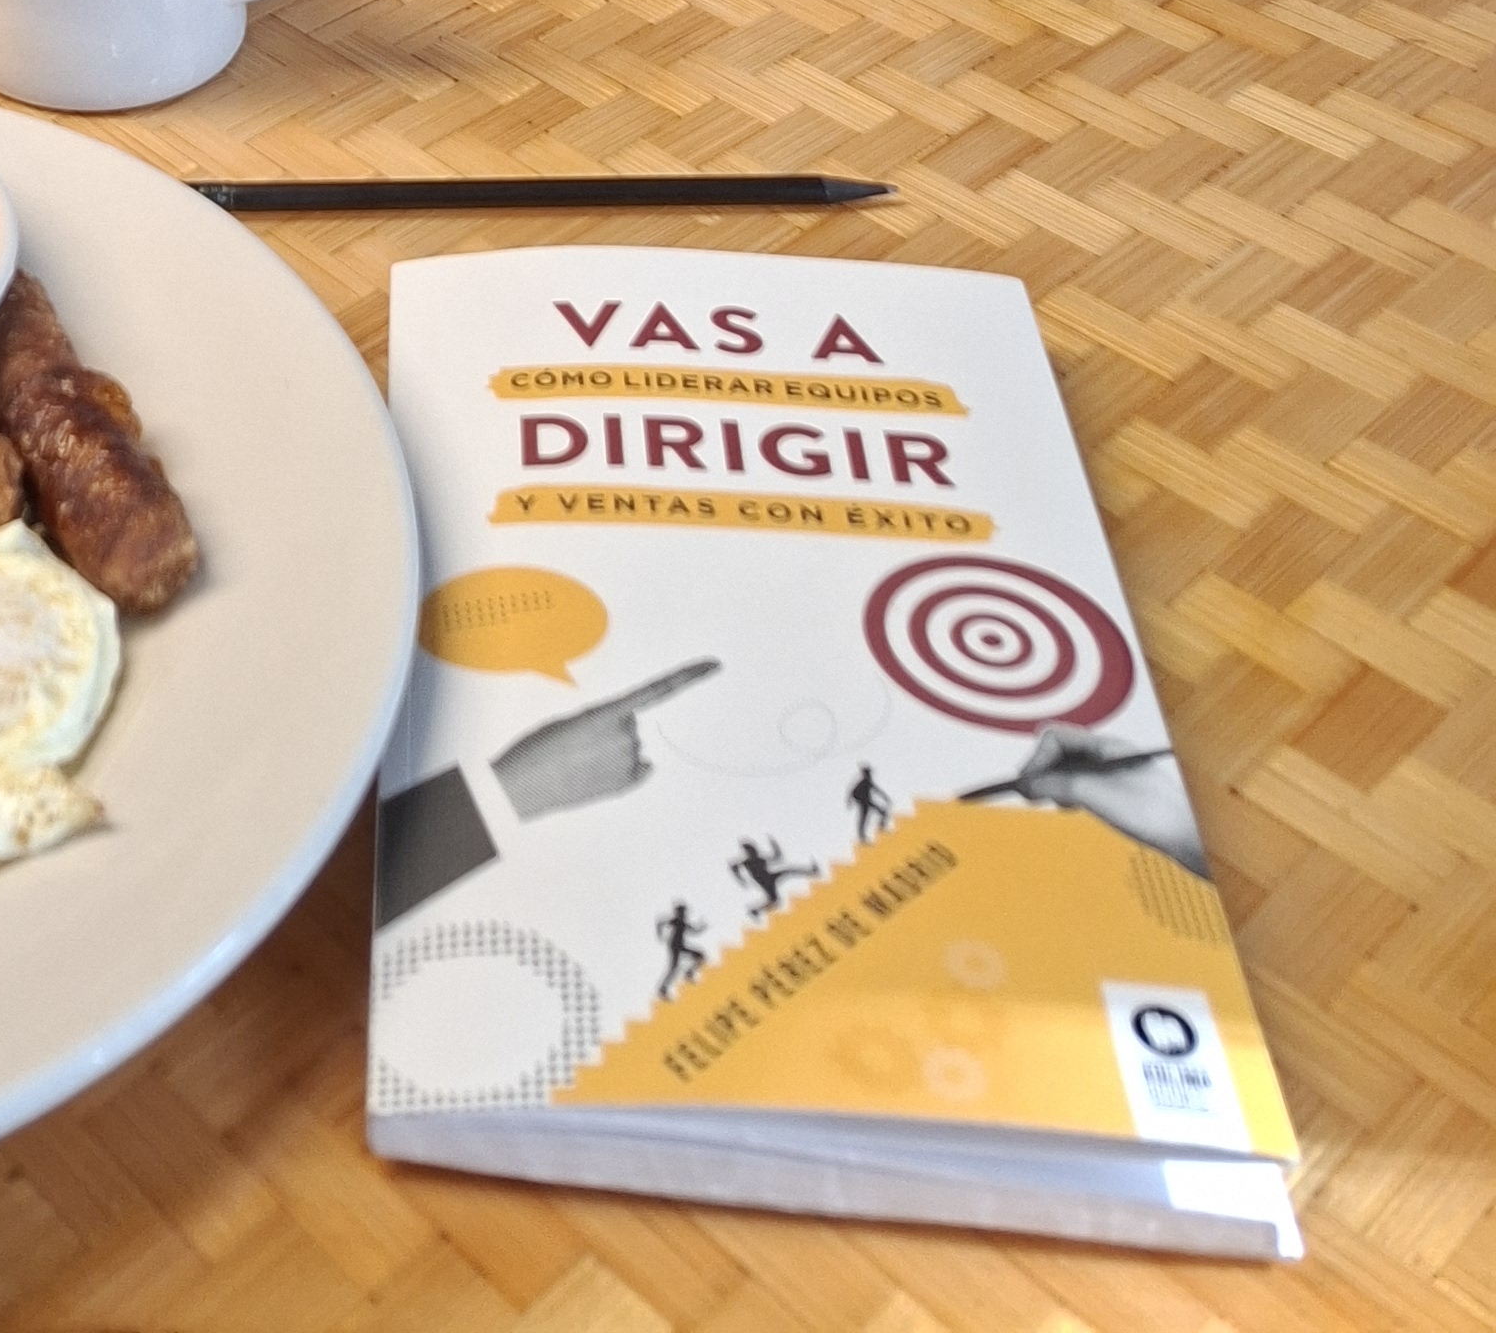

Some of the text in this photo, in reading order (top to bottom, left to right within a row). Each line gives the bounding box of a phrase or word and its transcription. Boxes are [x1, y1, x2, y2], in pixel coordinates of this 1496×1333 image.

[553, 300, 885, 366] VAS A
[510, 366, 944, 410] CÓMO LIDERAR EQUIPOS
[519, 412, 956, 489] DIRIGIR
[514, 491, 973, 535] Y VENTAS CON ÉXITO
[663, 994, 761, 1082] FELIPE
[825, 908, 873, 949] DE
[862, 838, 960, 922] MADRID
